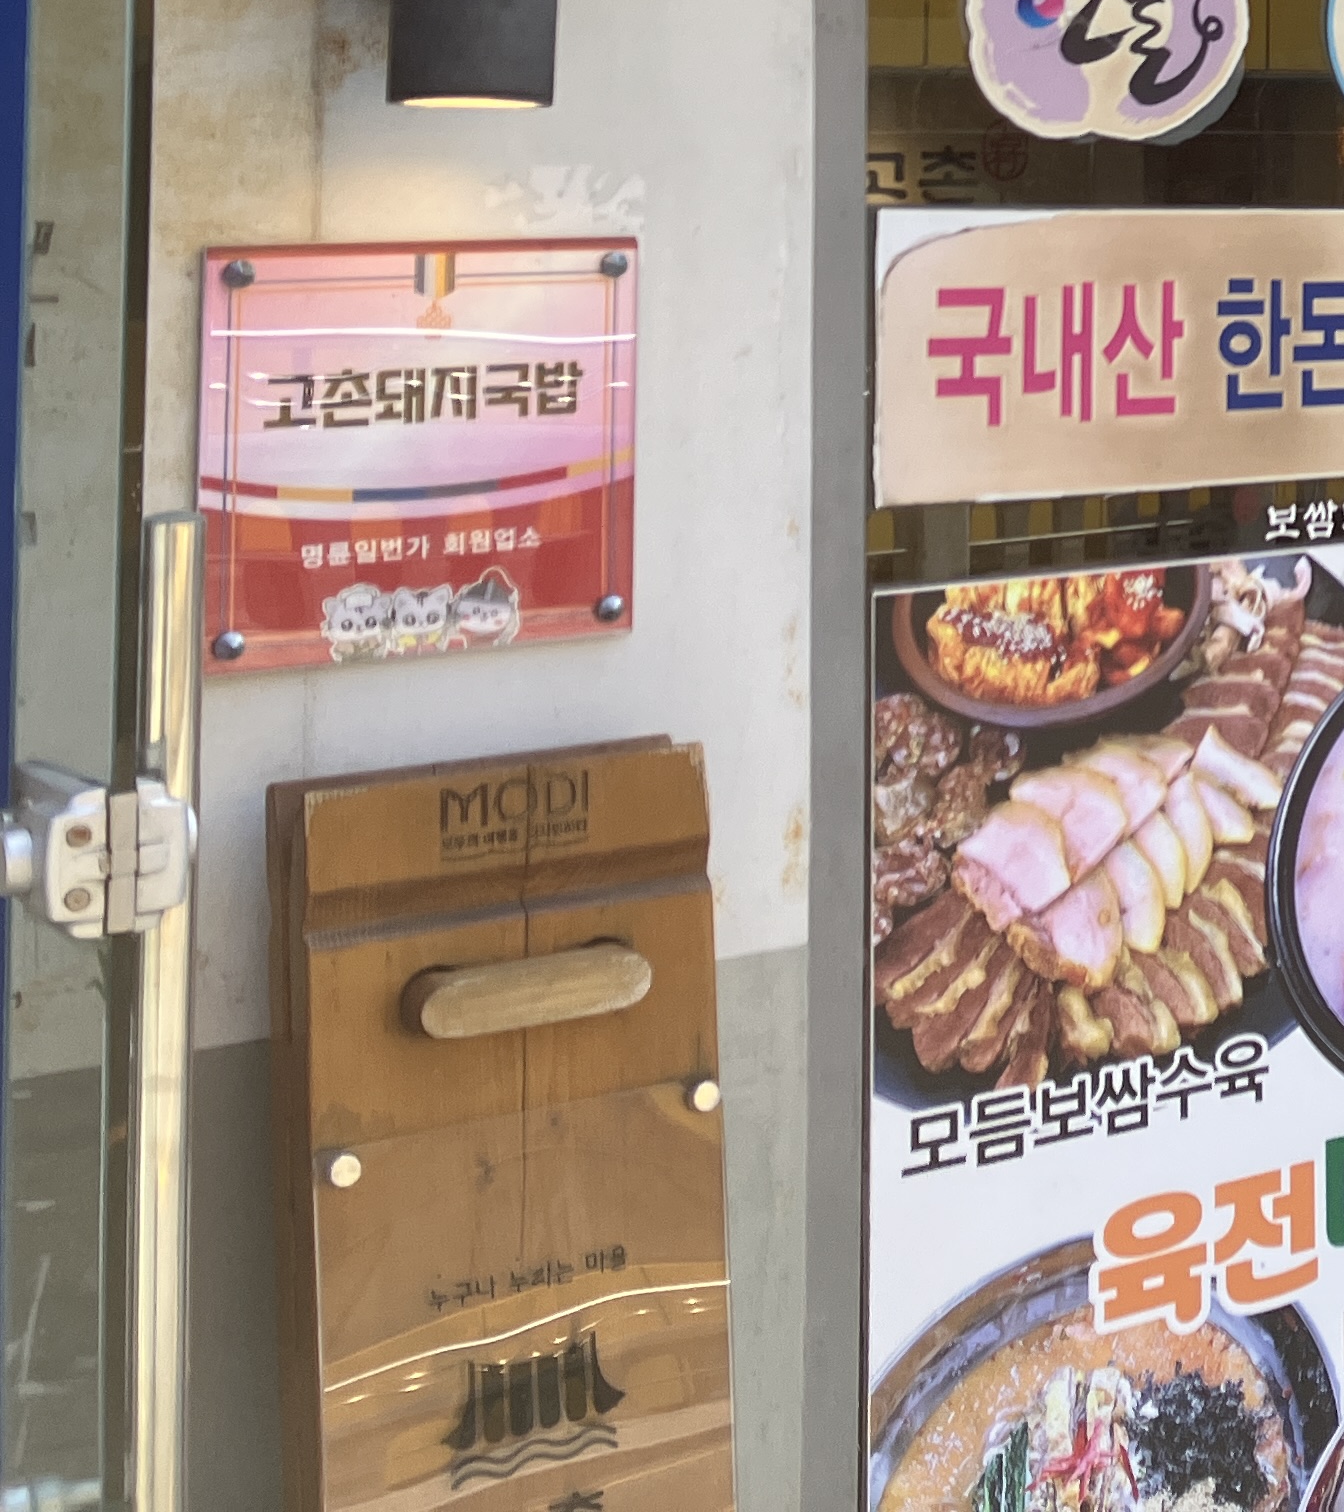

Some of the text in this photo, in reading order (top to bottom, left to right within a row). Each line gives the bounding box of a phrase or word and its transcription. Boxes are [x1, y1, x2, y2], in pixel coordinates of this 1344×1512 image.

[927, 279, 1185, 427] 국내산
[263, 359, 583, 431] 고촌돼지국밥
[443, 525, 543, 557] 회원업소
[440, 769, 589, 833] MODI
[901, 1038, 1270, 1179] 모듬보쌈수육
